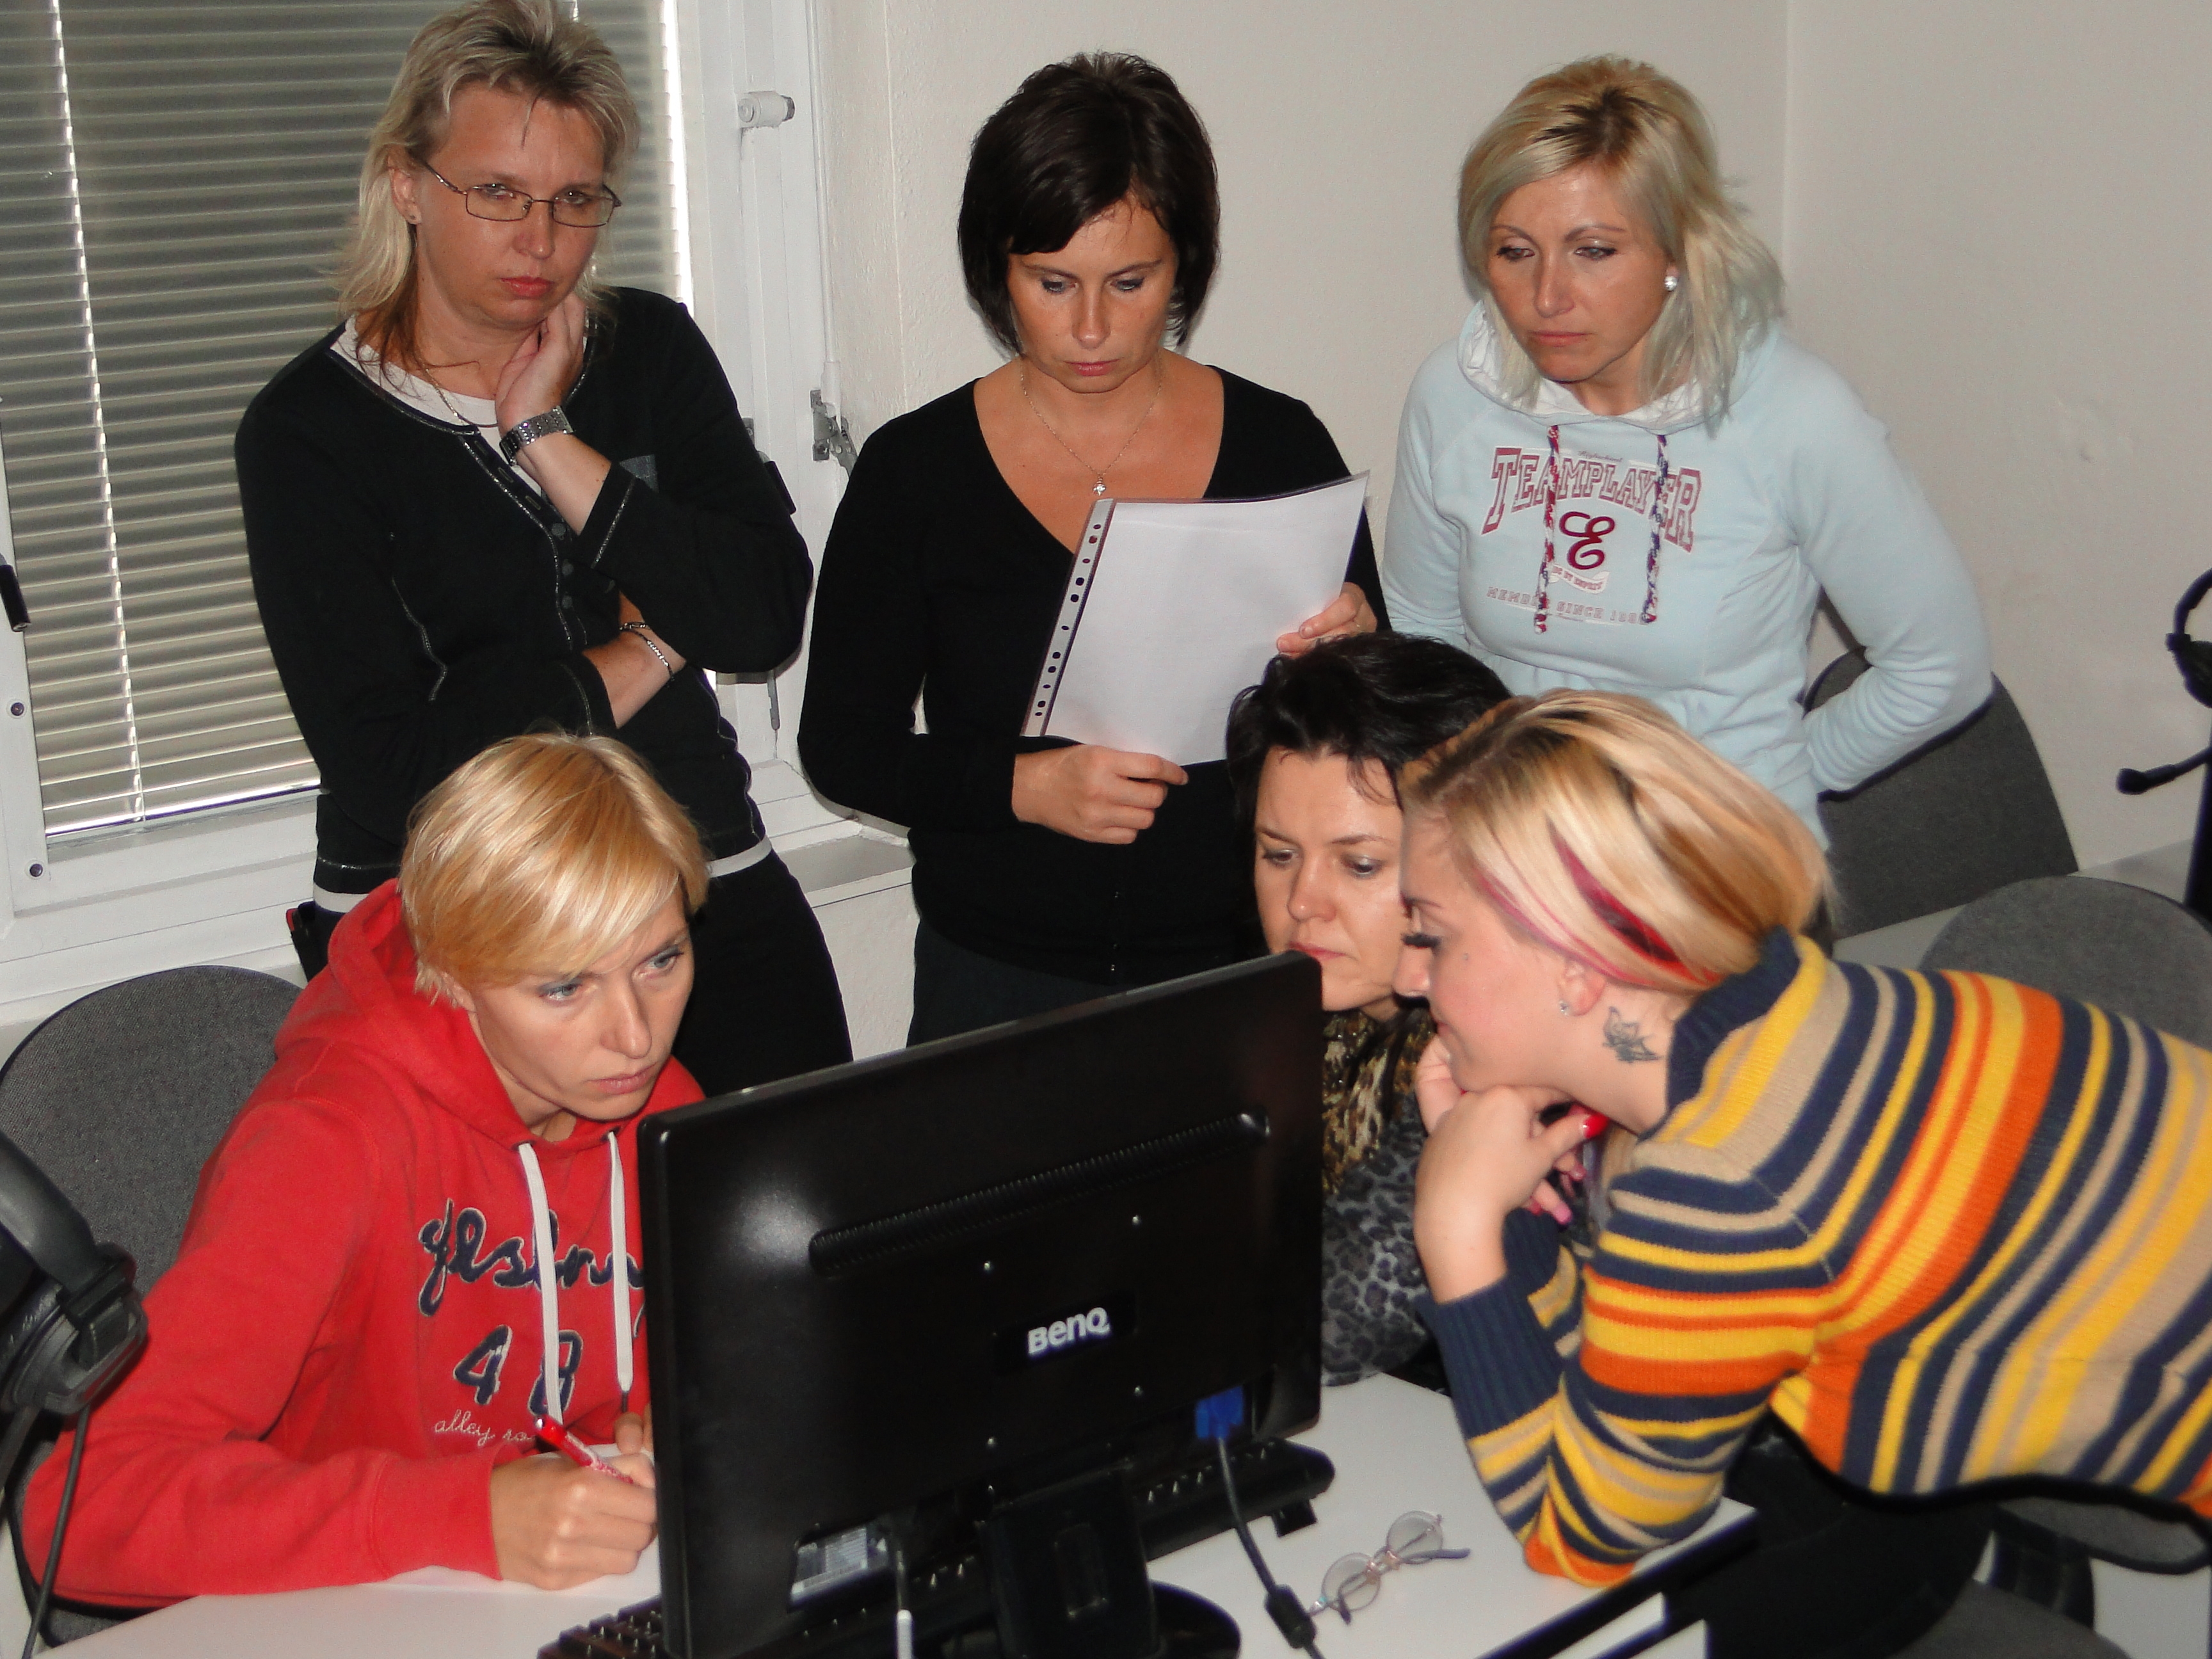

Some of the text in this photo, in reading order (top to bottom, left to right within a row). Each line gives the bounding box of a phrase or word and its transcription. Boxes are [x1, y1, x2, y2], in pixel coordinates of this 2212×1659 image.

[1487, 586, 1543, 607] MEMB
[1556, 601, 1604, 619] SINCE
[1028, 1307, 1110, 1355] BenQ
